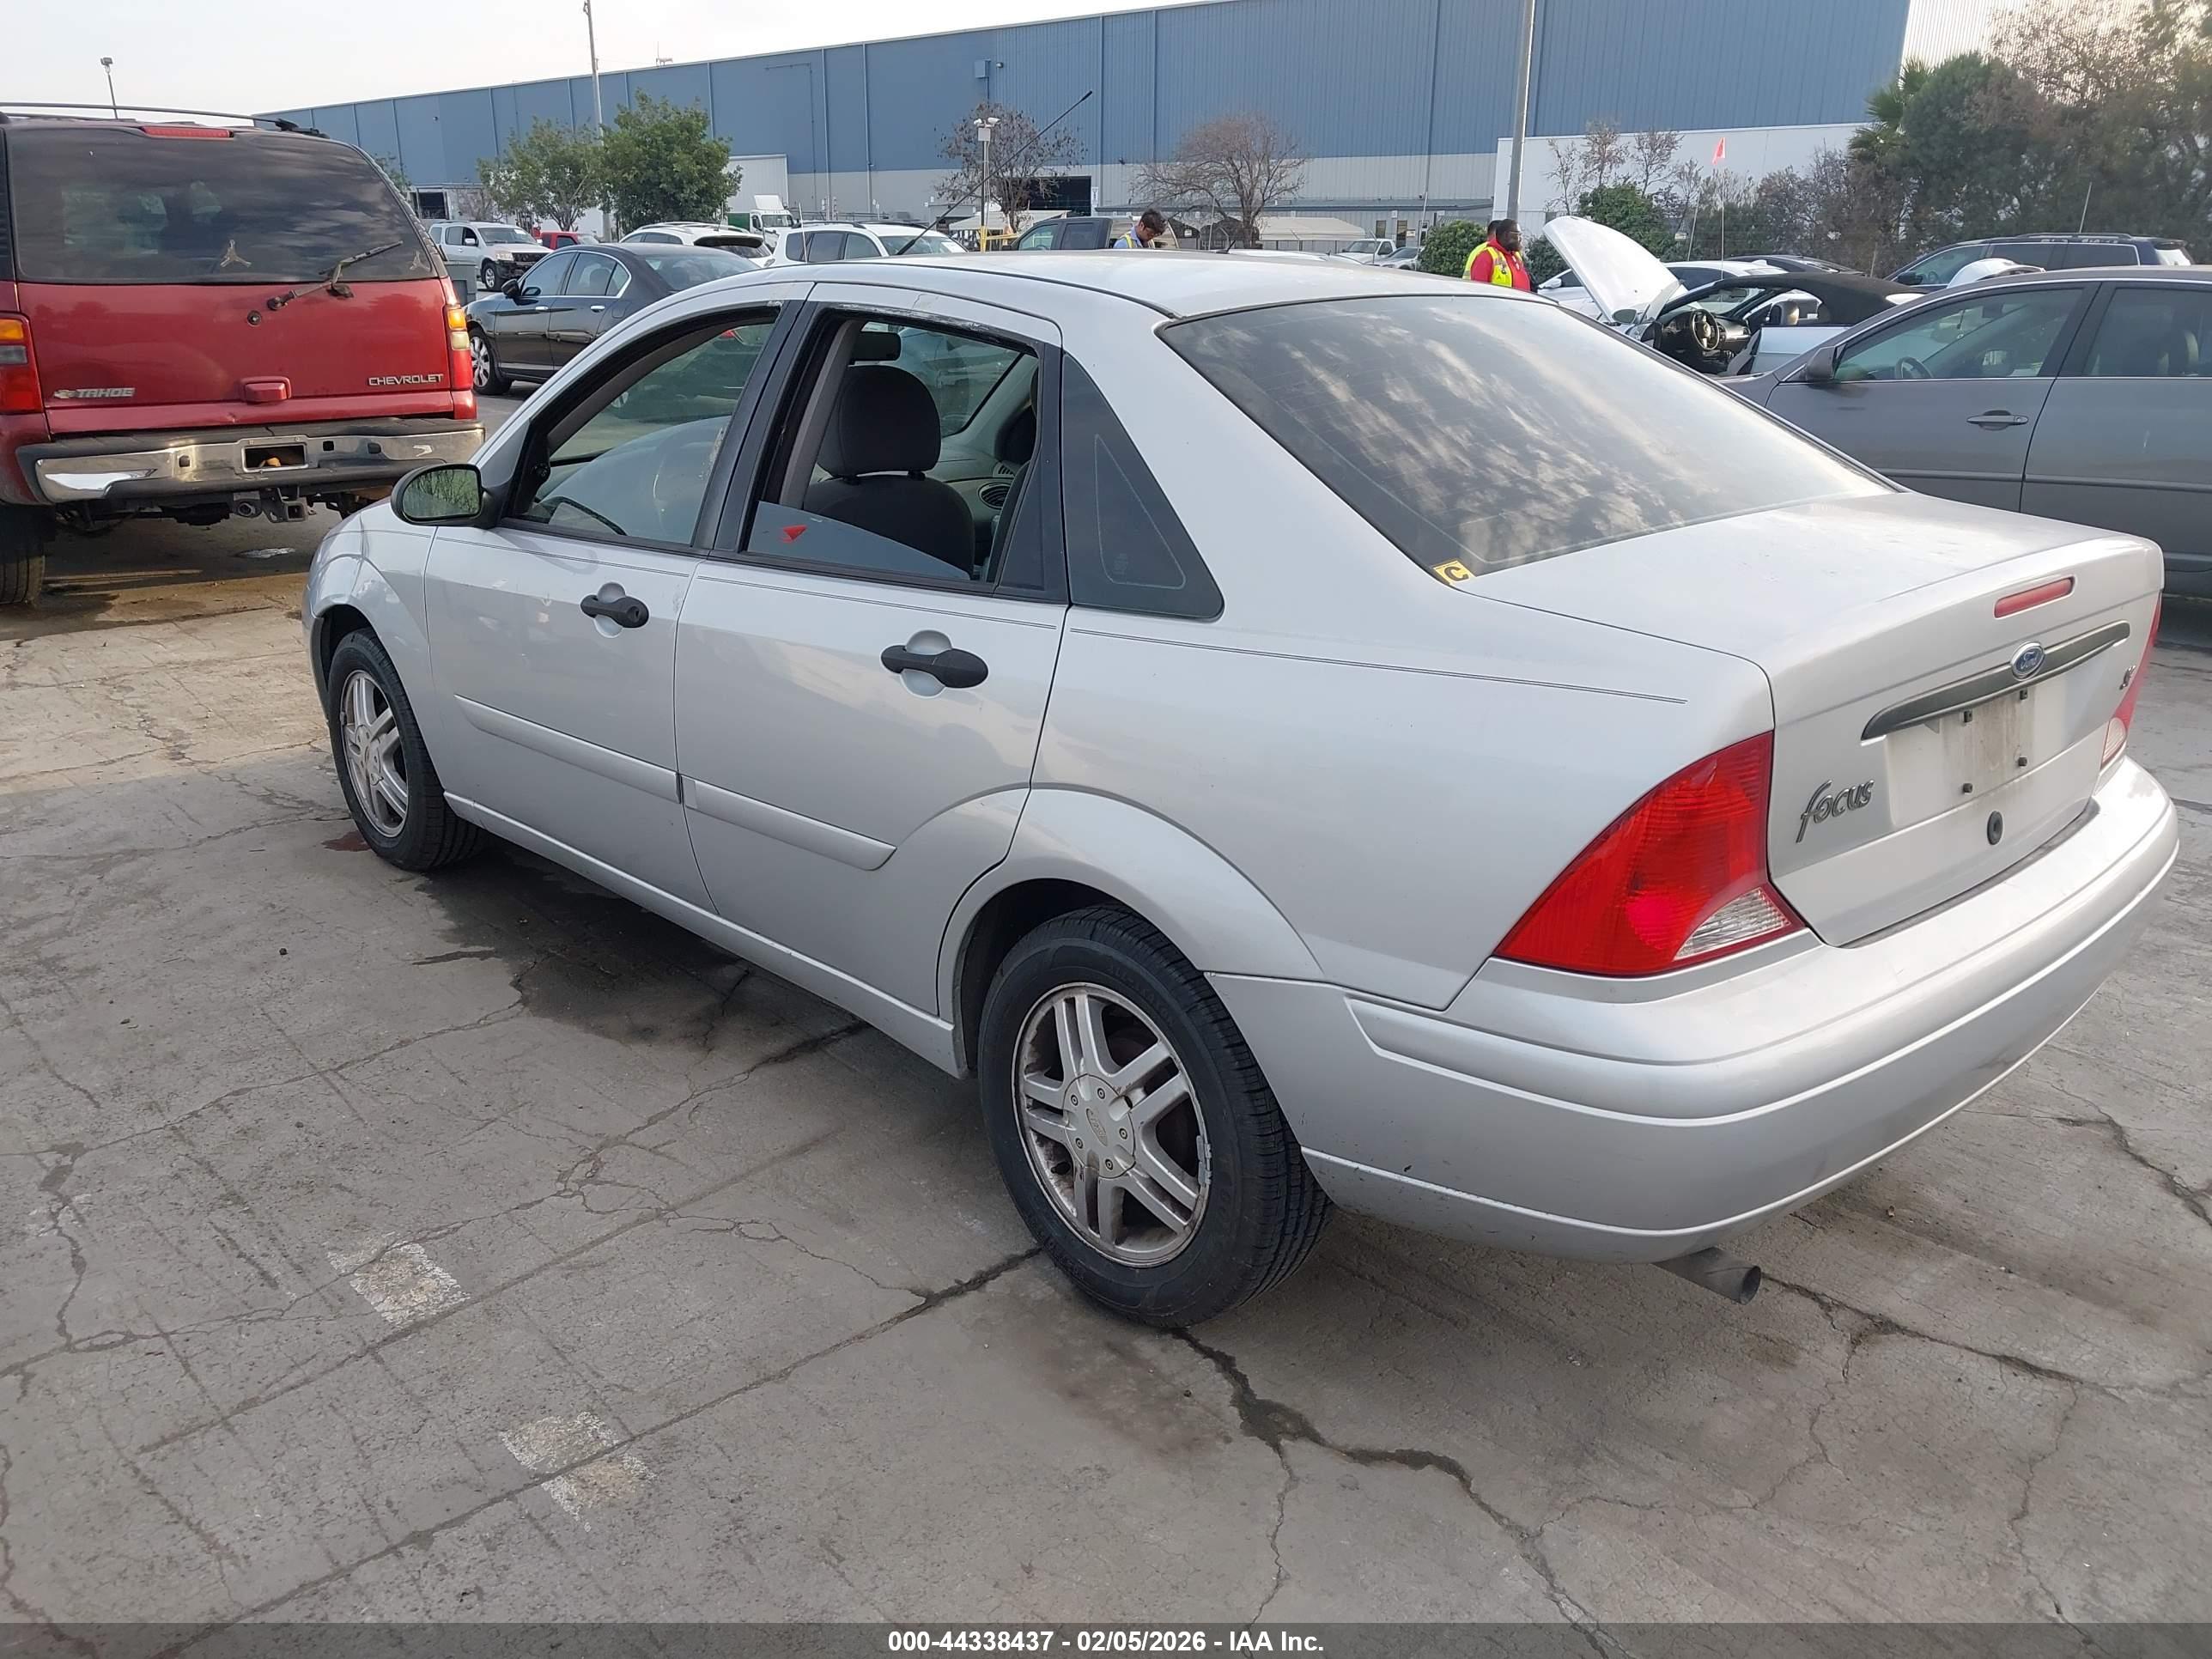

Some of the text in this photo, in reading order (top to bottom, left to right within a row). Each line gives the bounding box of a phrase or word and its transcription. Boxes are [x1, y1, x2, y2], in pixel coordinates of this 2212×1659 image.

[368, 373, 444, 386] CHEVROLET
[76, 387, 136, 398] TAHOE
[1443, 566, 1469, 581] C
